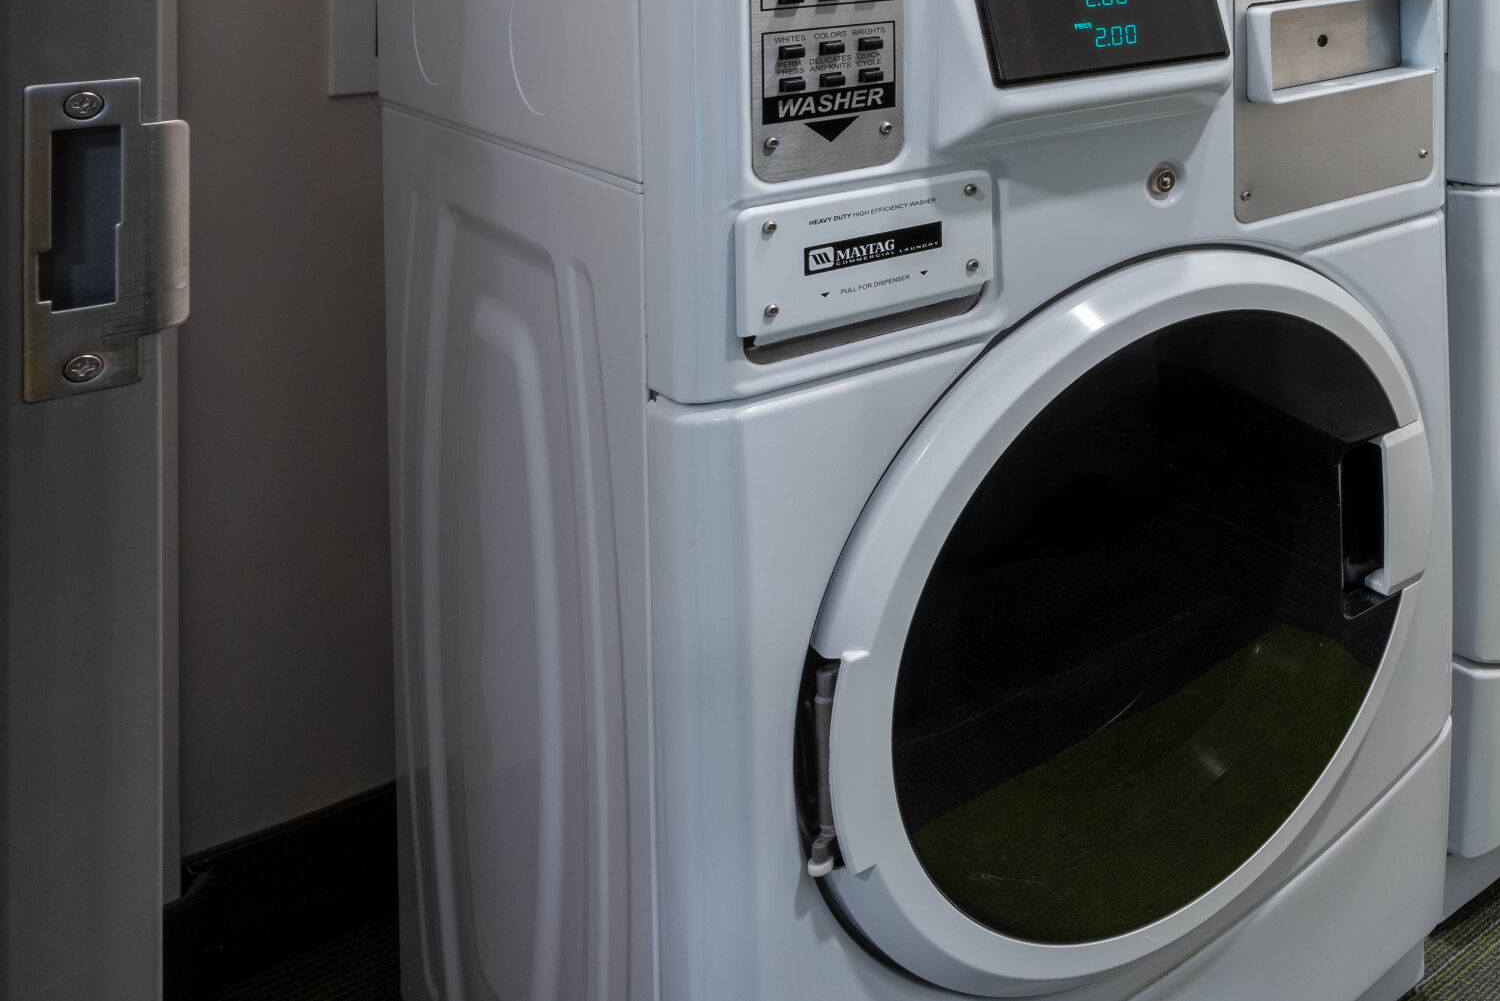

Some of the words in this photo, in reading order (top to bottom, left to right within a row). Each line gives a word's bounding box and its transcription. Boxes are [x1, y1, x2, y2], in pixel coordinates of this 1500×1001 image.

[814, 31, 847, 40] COLORS
[852, 27, 886, 36] BRIGHTS
[1074, 22, 1093, 31] PRICE
[1095, 24, 1137, 48] 2.00
[775, 34, 806, 43] WHITES
[809, 54, 852, 65] DELICATES
[856, 51, 881, 60] QUICK
[777, 60, 801, 68] PERM
[810, 64, 827, 72] AND
[828, 61, 851, 70] KNITS
[856, 59, 882, 67] CYCLE
[776, 67, 805, 75] PRESS
[777, 87, 885, 118] WASHER
[809, 217, 831, 226] HEAVY
[833, 213, 852, 222] DUTY
[853, 210, 869, 218] HIGH
[871, 202, 908, 215] EFFICIENCY
[909, 197, 937, 207] WASHER
[836, 239, 895, 261] MAYTAG
[836, 250, 896, 266] COMMERCIAL
[899, 241, 939, 253] LAUNDRY
[840, 286, 857, 294] PULL
[858, 282, 873, 290] FOR
[873, 274, 911, 288] DISPENSER
